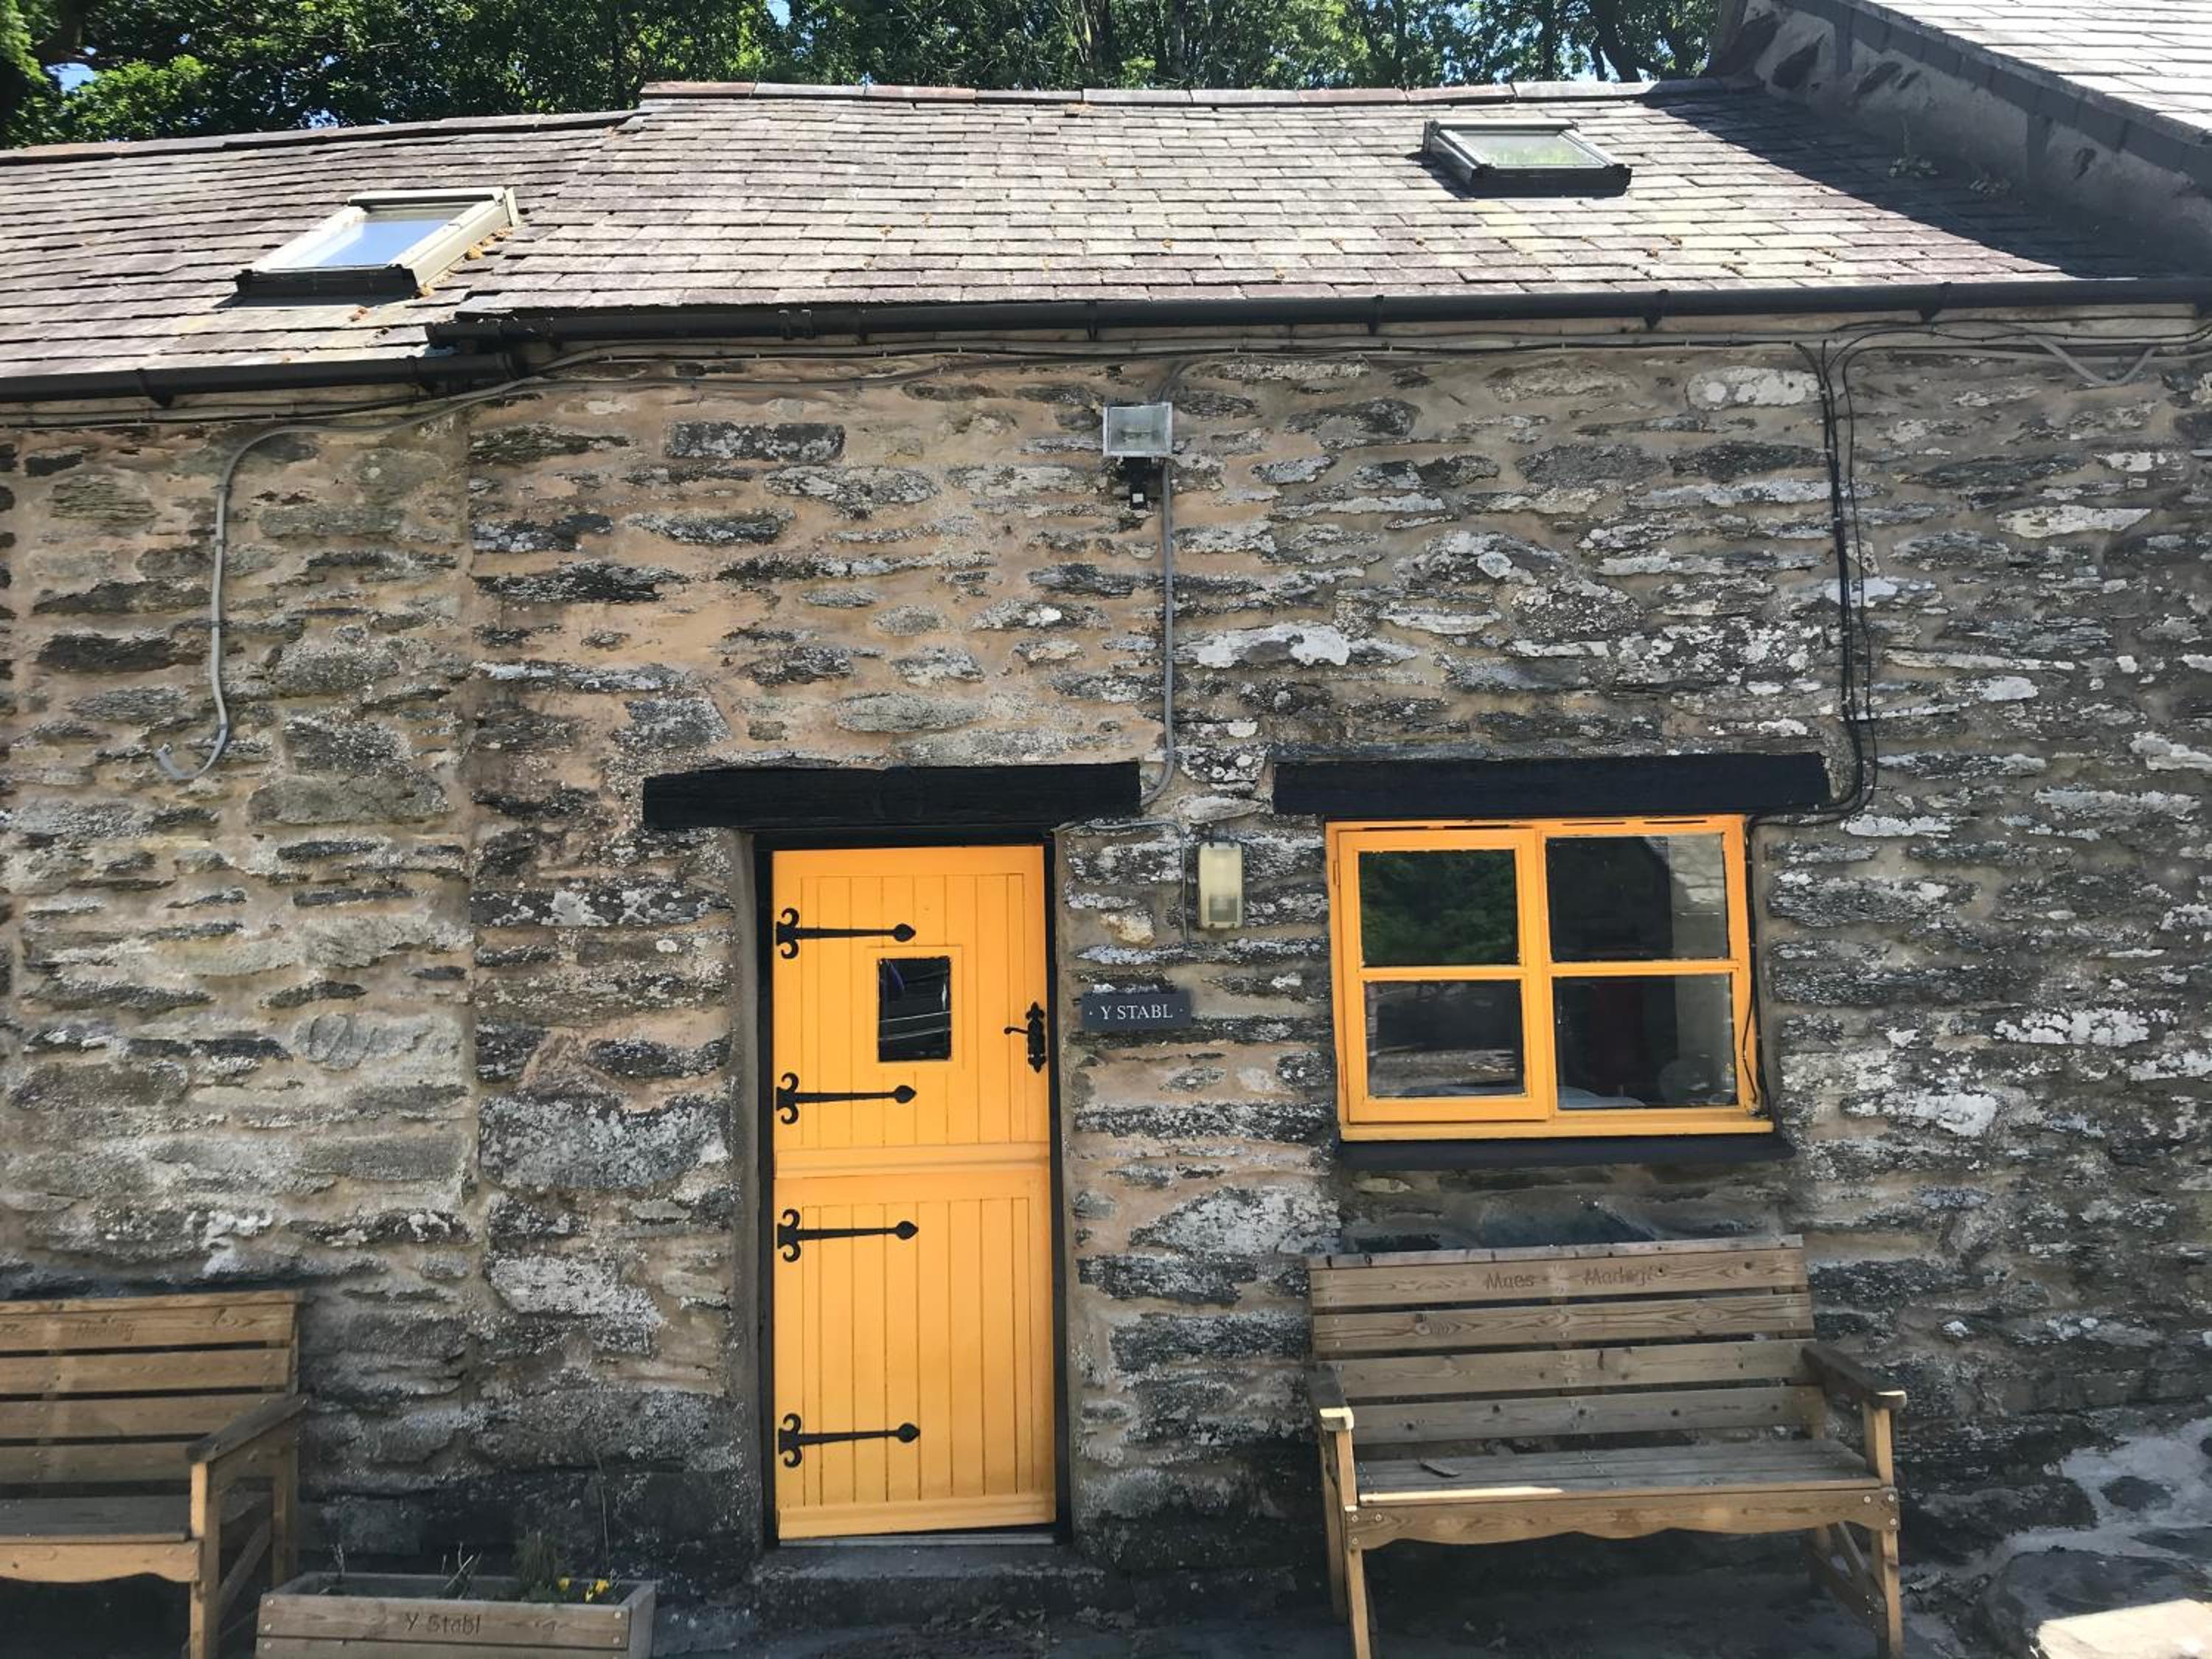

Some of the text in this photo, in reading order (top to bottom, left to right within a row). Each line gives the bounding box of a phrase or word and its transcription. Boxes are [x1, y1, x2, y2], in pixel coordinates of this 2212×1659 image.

[1100, 1004, 1174, 1020] Y STABL
[406, 1612, 481, 1635] Y Stabl
